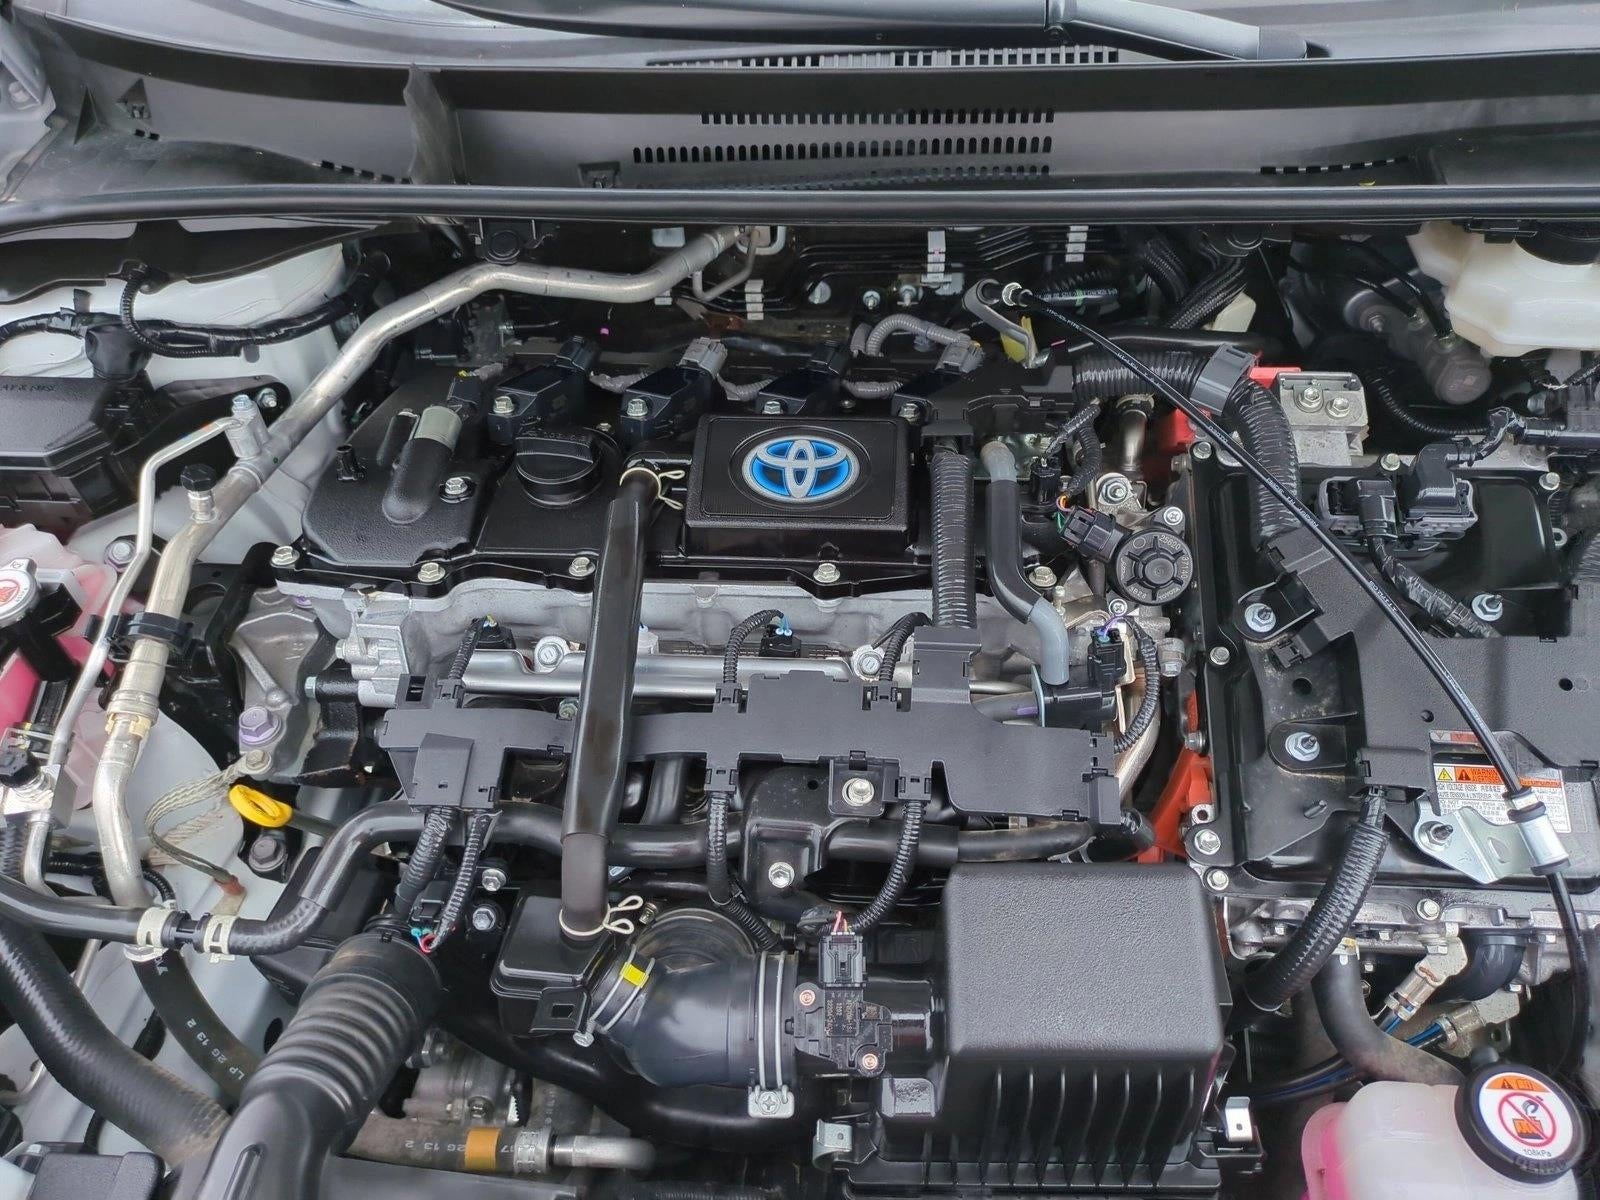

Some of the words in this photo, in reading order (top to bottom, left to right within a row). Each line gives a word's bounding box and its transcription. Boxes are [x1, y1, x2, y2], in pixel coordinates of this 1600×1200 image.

[1160, 534, 1181, 551] 25620
[1181, 555, 1191, 579] 37140
[1158, 587, 1181, 601] TOYOTA
[186, 1018, 197, 1029] 2
[196, 1031, 210, 1047] 13
[229, 1066, 245, 1081] LP
[405, 1141, 415, 1149] 2
[424, 1141, 440, 1150] 13
